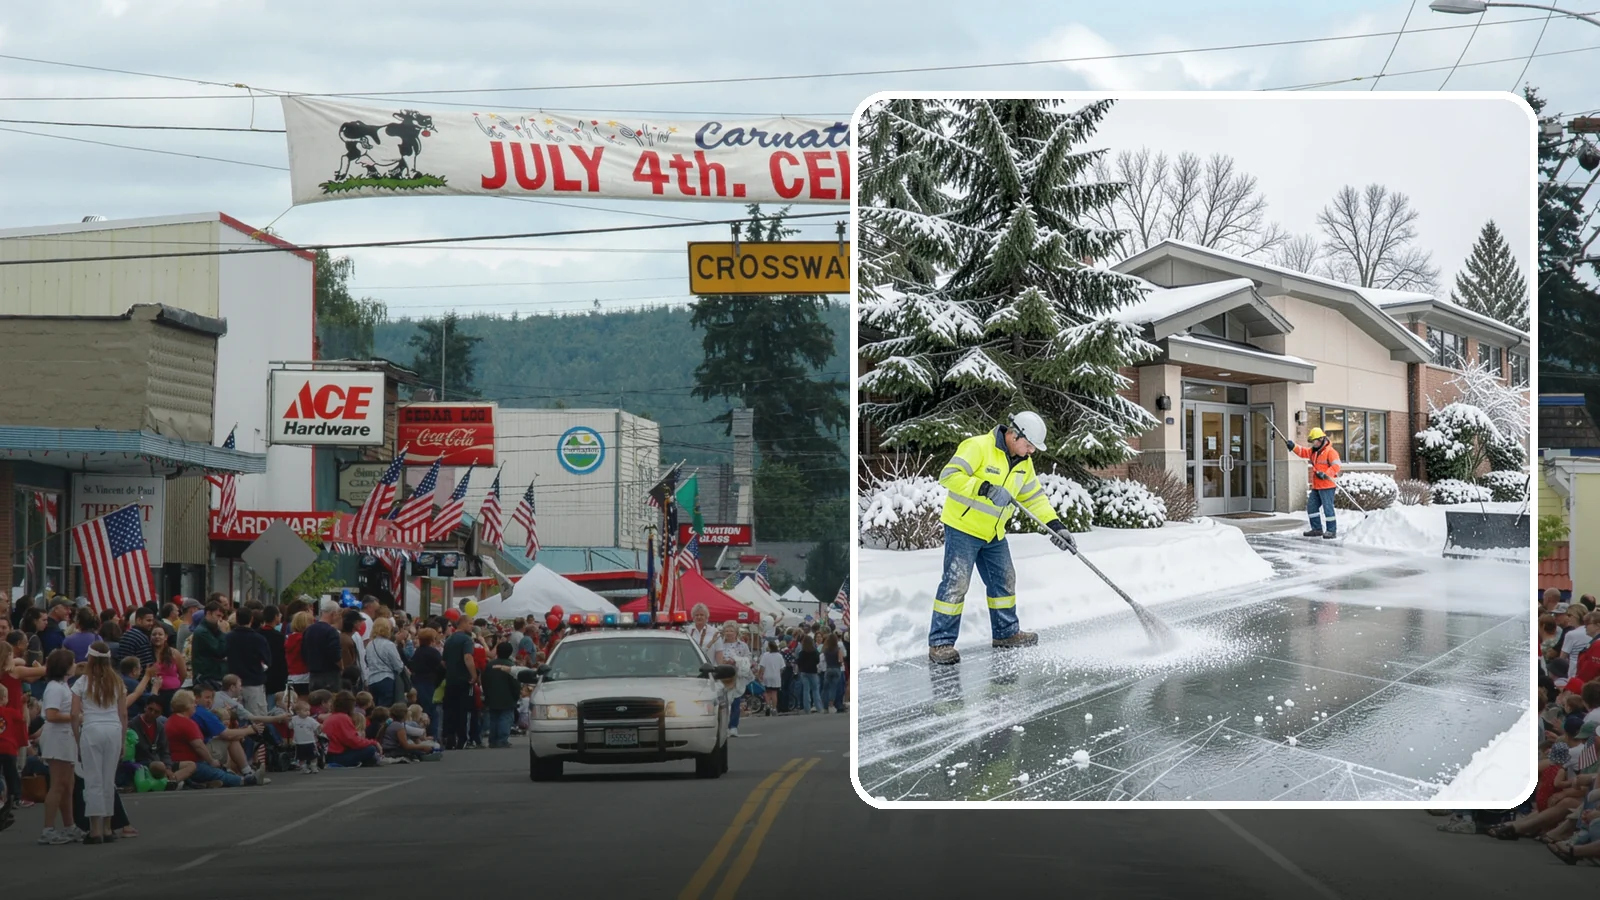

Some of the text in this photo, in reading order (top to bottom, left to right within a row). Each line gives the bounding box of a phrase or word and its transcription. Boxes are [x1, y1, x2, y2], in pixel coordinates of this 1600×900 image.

[481, 141, 605, 192] JULY
[632, 150, 746, 198] 4th.
[697, 254, 850, 279] CROSSWA
[283, 380, 373, 419] ACE
[405, 409, 452, 421] CEDAR
[284, 421, 370, 436] Hardware
[416, 428, 476, 447] Coca-Cola
[353, 467, 385, 481] Simpl
[96, 486, 124, 494] Vincent
[126, 486, 136, 495] de
[137, 486, 155, 495] Paul
[81, 504, 153, 521] THT
[688, 526, 741, 535] CRNATION
[699, 535, 730, 544] GLASS
